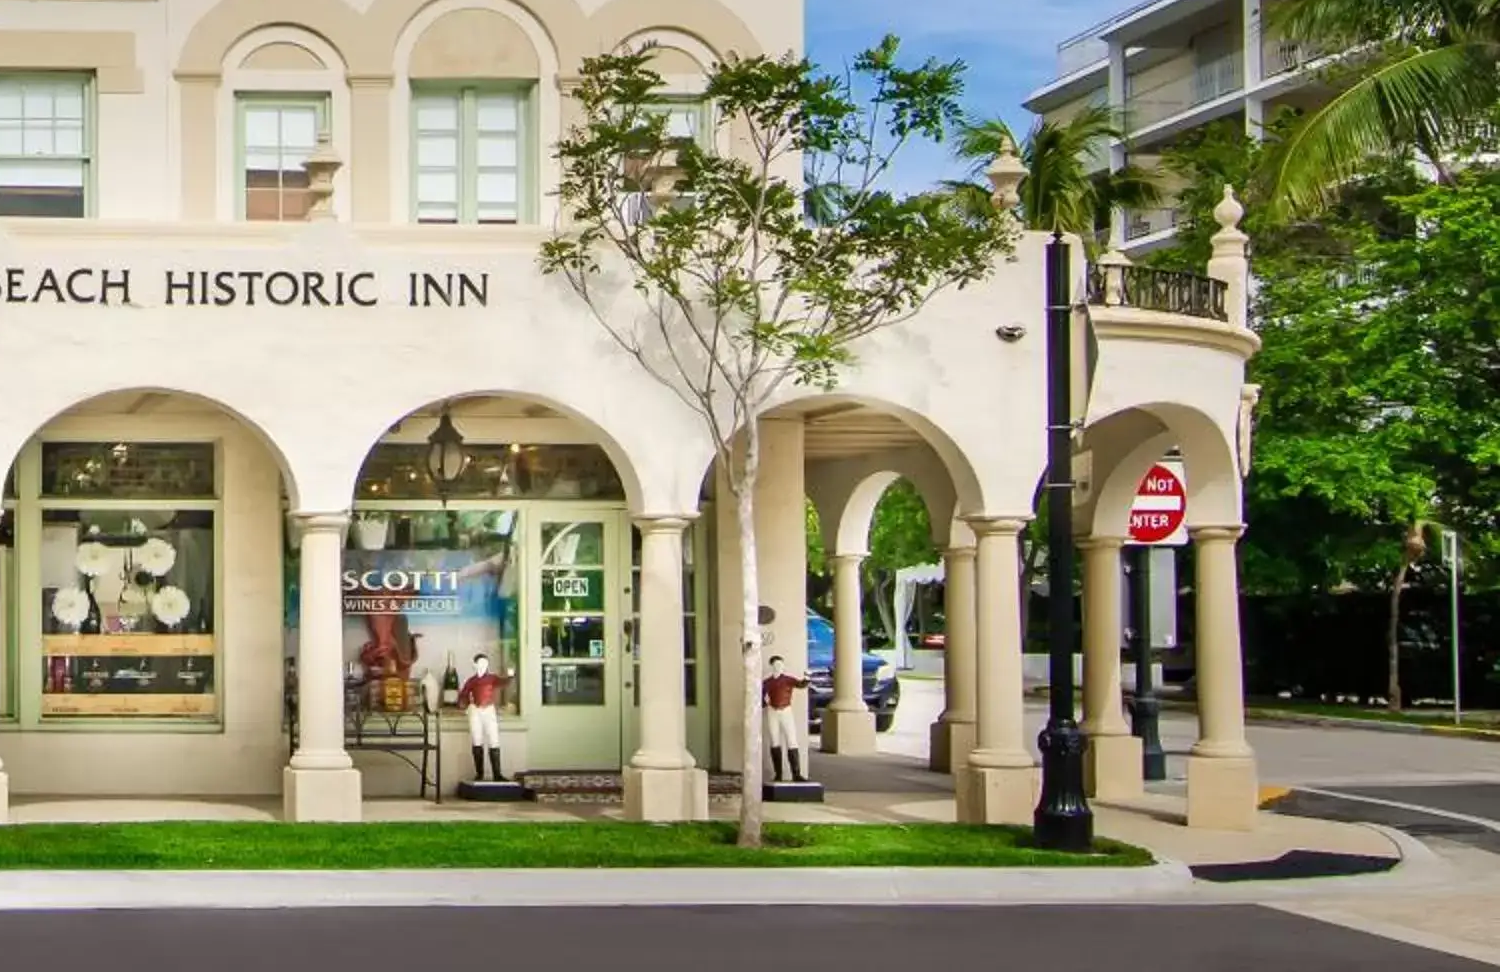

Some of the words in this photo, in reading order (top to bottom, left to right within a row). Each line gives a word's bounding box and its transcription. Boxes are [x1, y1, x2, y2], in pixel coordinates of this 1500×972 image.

[164, 270, 378, 307] HISTORIC
[408, 272, 489, 307] INN
[1147, 476, 1174, 492] NOT
[1130, 514, 1169, 528] NTER
[342, 569, 457, 591] SCOTTI
[555, 579, 587, 594] OPEN
[343, 599, 385, 611] WINES
[389, 599, 399, 611] &
